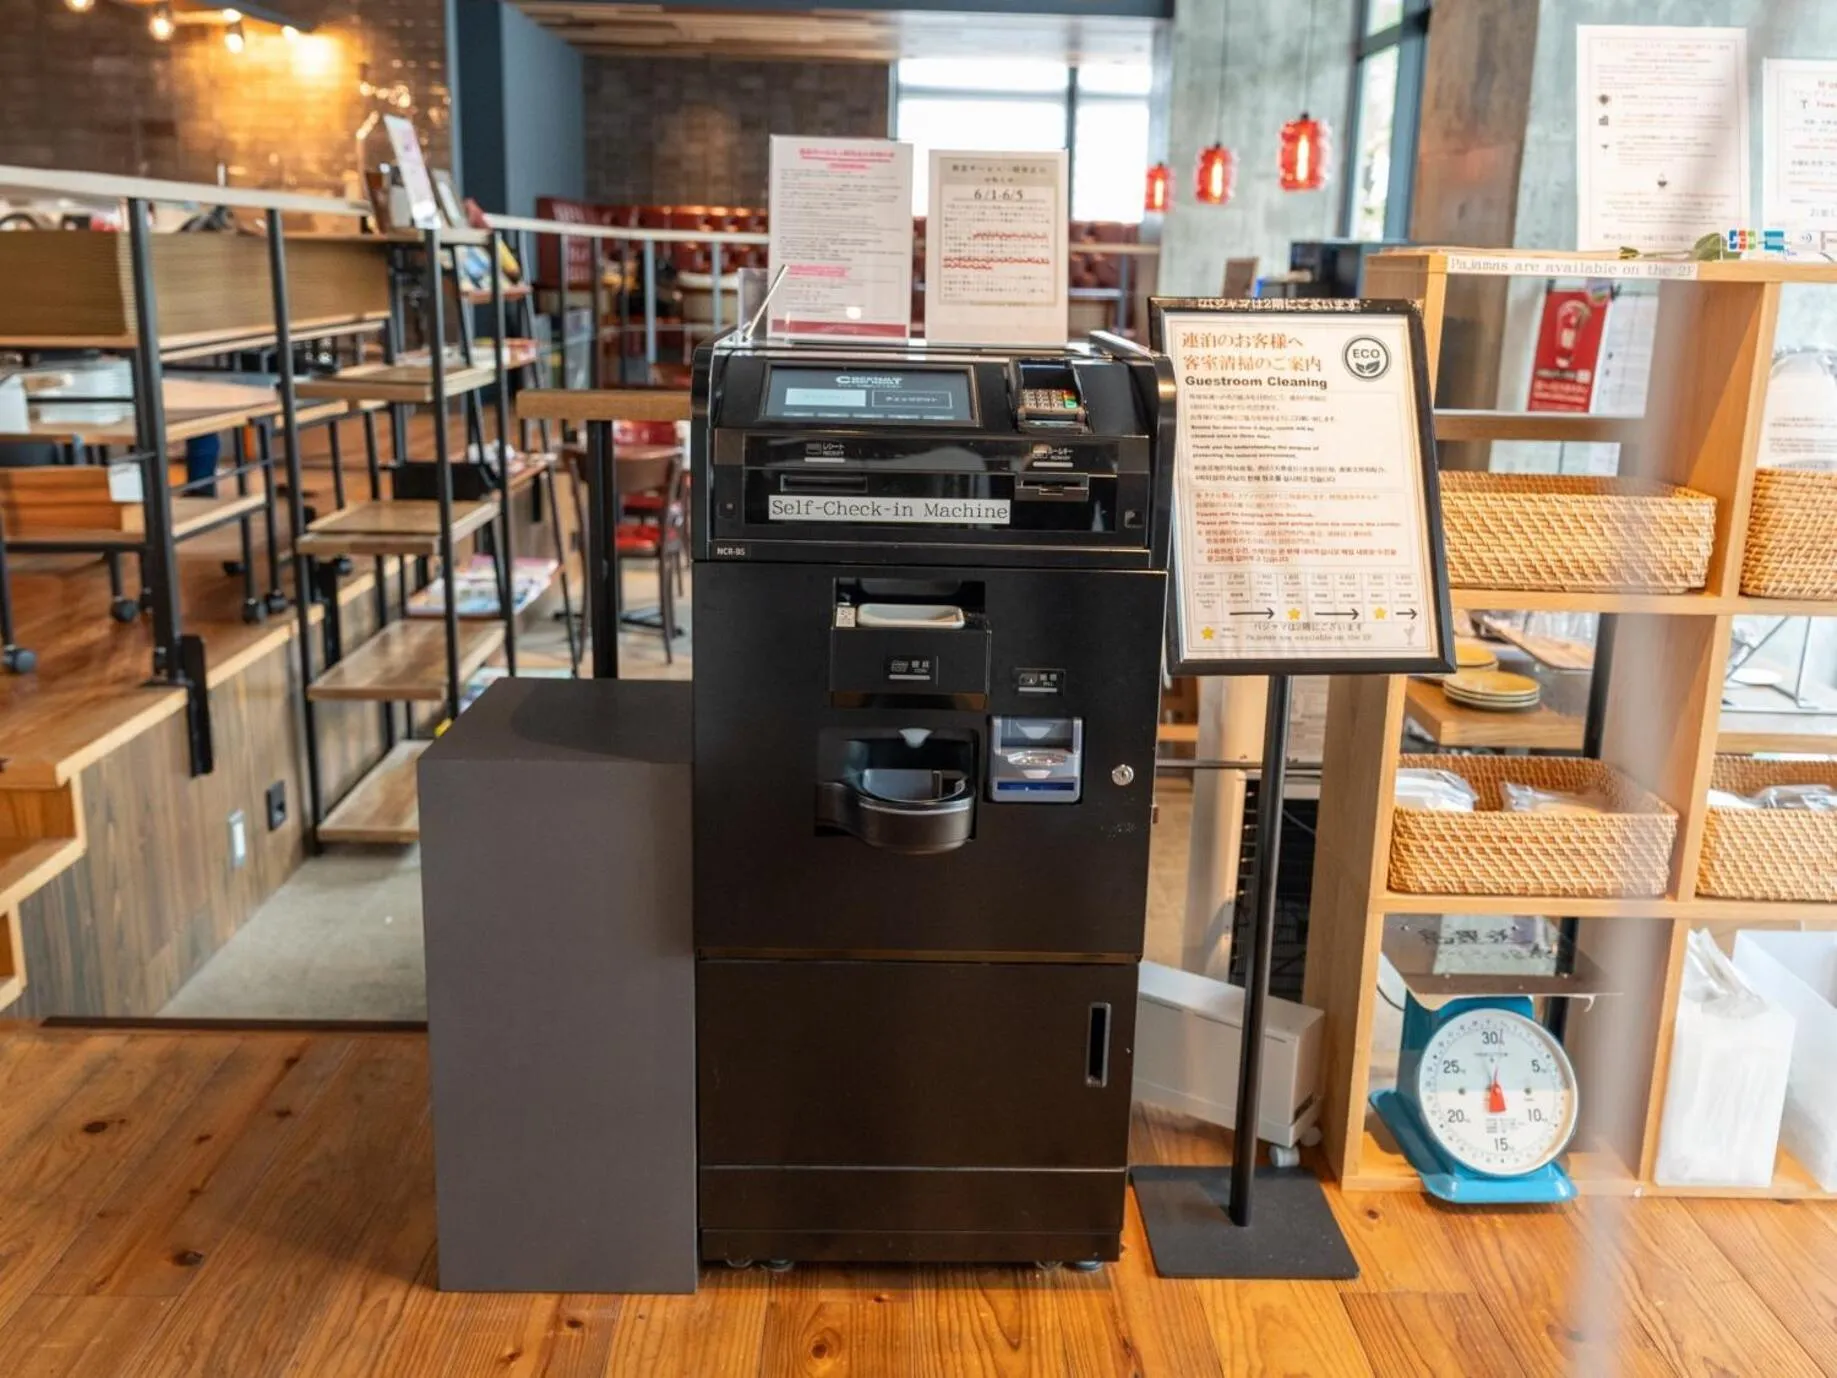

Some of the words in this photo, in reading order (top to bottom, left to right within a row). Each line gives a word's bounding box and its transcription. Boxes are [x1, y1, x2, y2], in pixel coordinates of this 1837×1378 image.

[1514, 261, 1540, 272] are
[1545, 260, 1617, 275] available
[1622, 264, 1640, 275] on
[1647, 262, 1671, 276] the
[1181, 332, 1305, 350] 連泊のお客様へ
[1352, 348, 1380, 359] ECO
[1183, 354, 1322, 373] 客室清掃のご案内
[1185, 375, 1263, 388] Guestroom
[1267, 376, 1328, 390] Cleaning
[771, 499, 914, 517] Self-Check-in
[923, 502, 1009, 519] Machine
